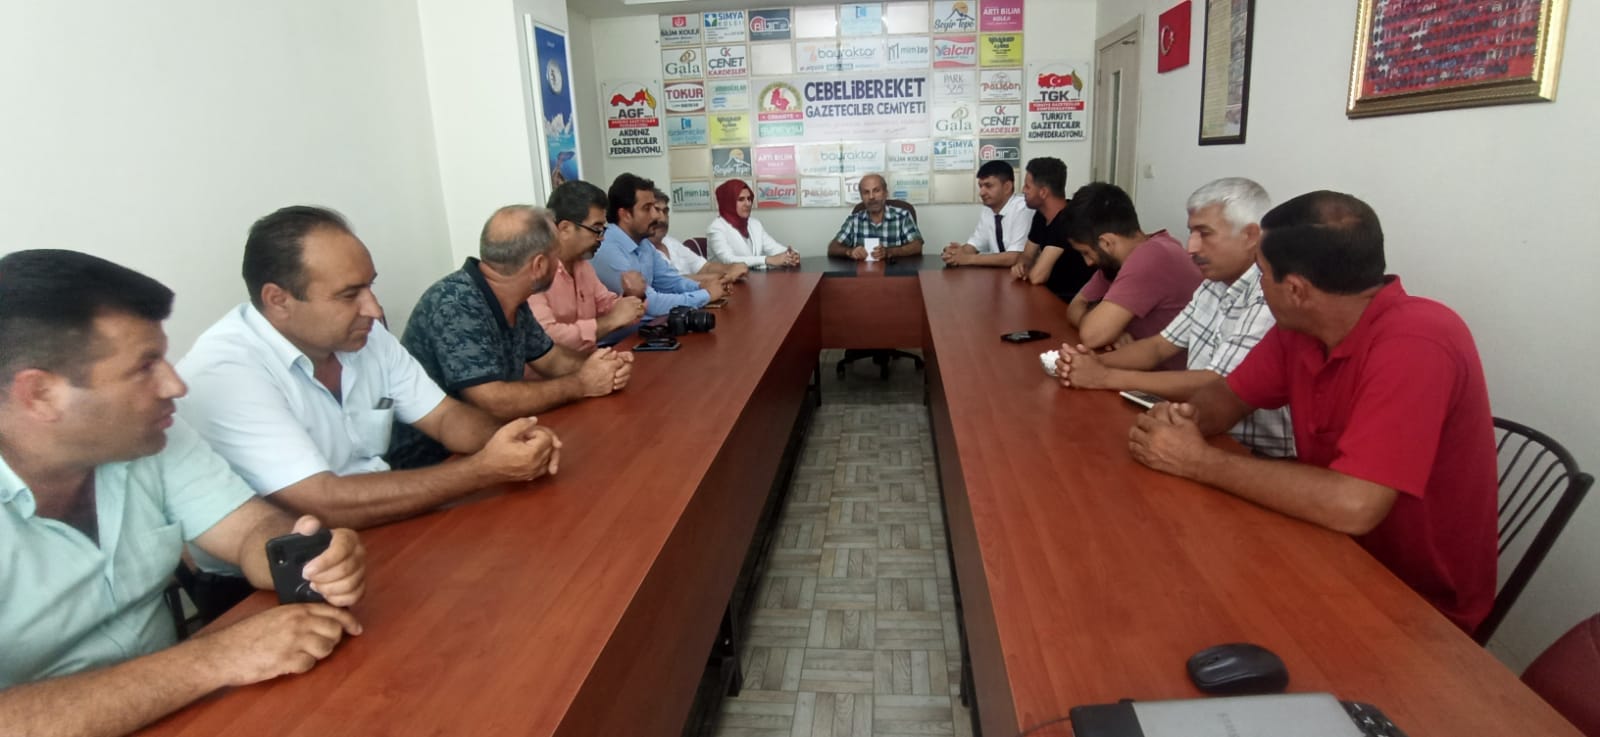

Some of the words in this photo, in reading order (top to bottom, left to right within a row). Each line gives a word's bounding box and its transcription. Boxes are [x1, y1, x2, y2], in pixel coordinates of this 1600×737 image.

[665, 62, 701, 75] Gala
[665, 88, 704, 100] TOKUR
[1040, 90, 1070, 102] TGK
[618, 108, 645, 118] AGF
[805, 102, 875, 118] GAZETECİLER
[876, 100, 927, 115] CEMİYETİ
[936, 119, 972, 132] Gala
